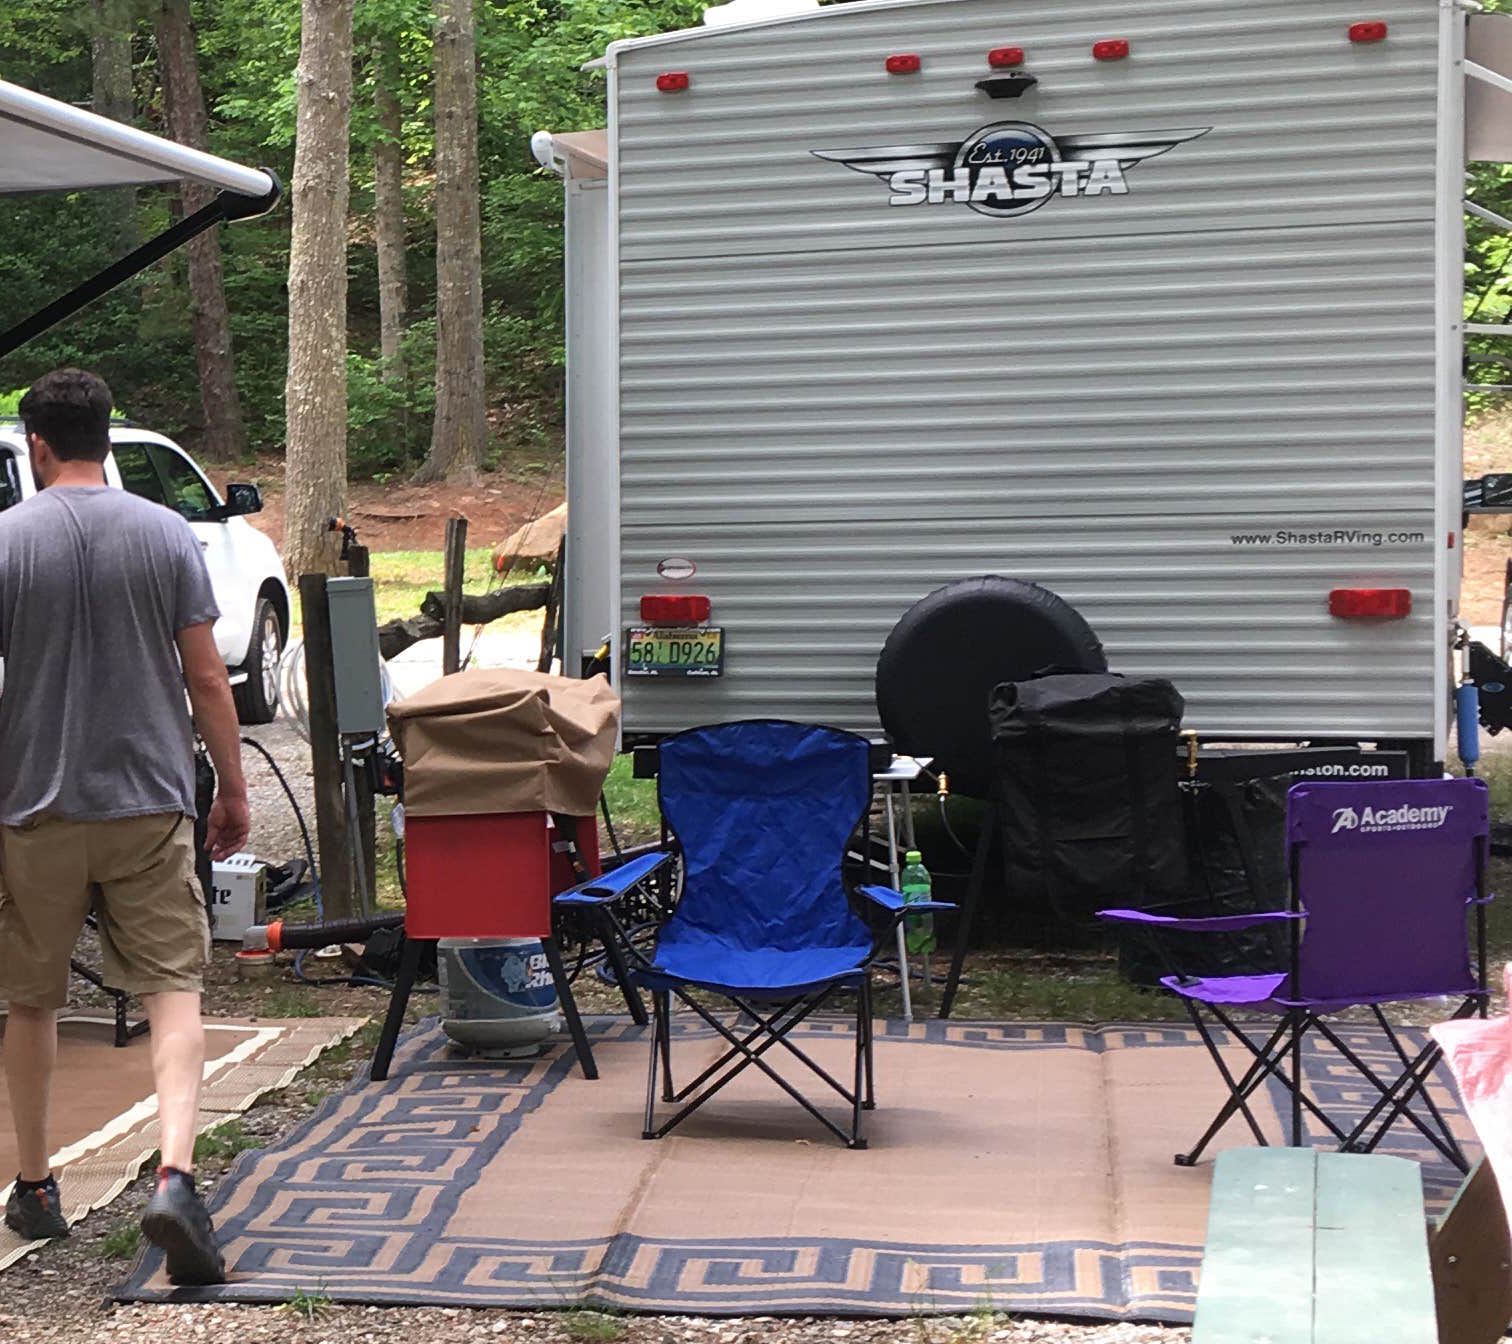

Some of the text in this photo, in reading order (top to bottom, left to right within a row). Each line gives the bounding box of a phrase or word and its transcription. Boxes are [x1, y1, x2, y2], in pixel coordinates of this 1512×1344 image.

[889, 159, 1130, 206] SHASTA
[1230, 530, 1425, 546] www.ShastaRVing.com
[631, 641, 654, 664] 58
[669, 641, 716, 664] D926
[1360, 804, 1448, 826] Academy
